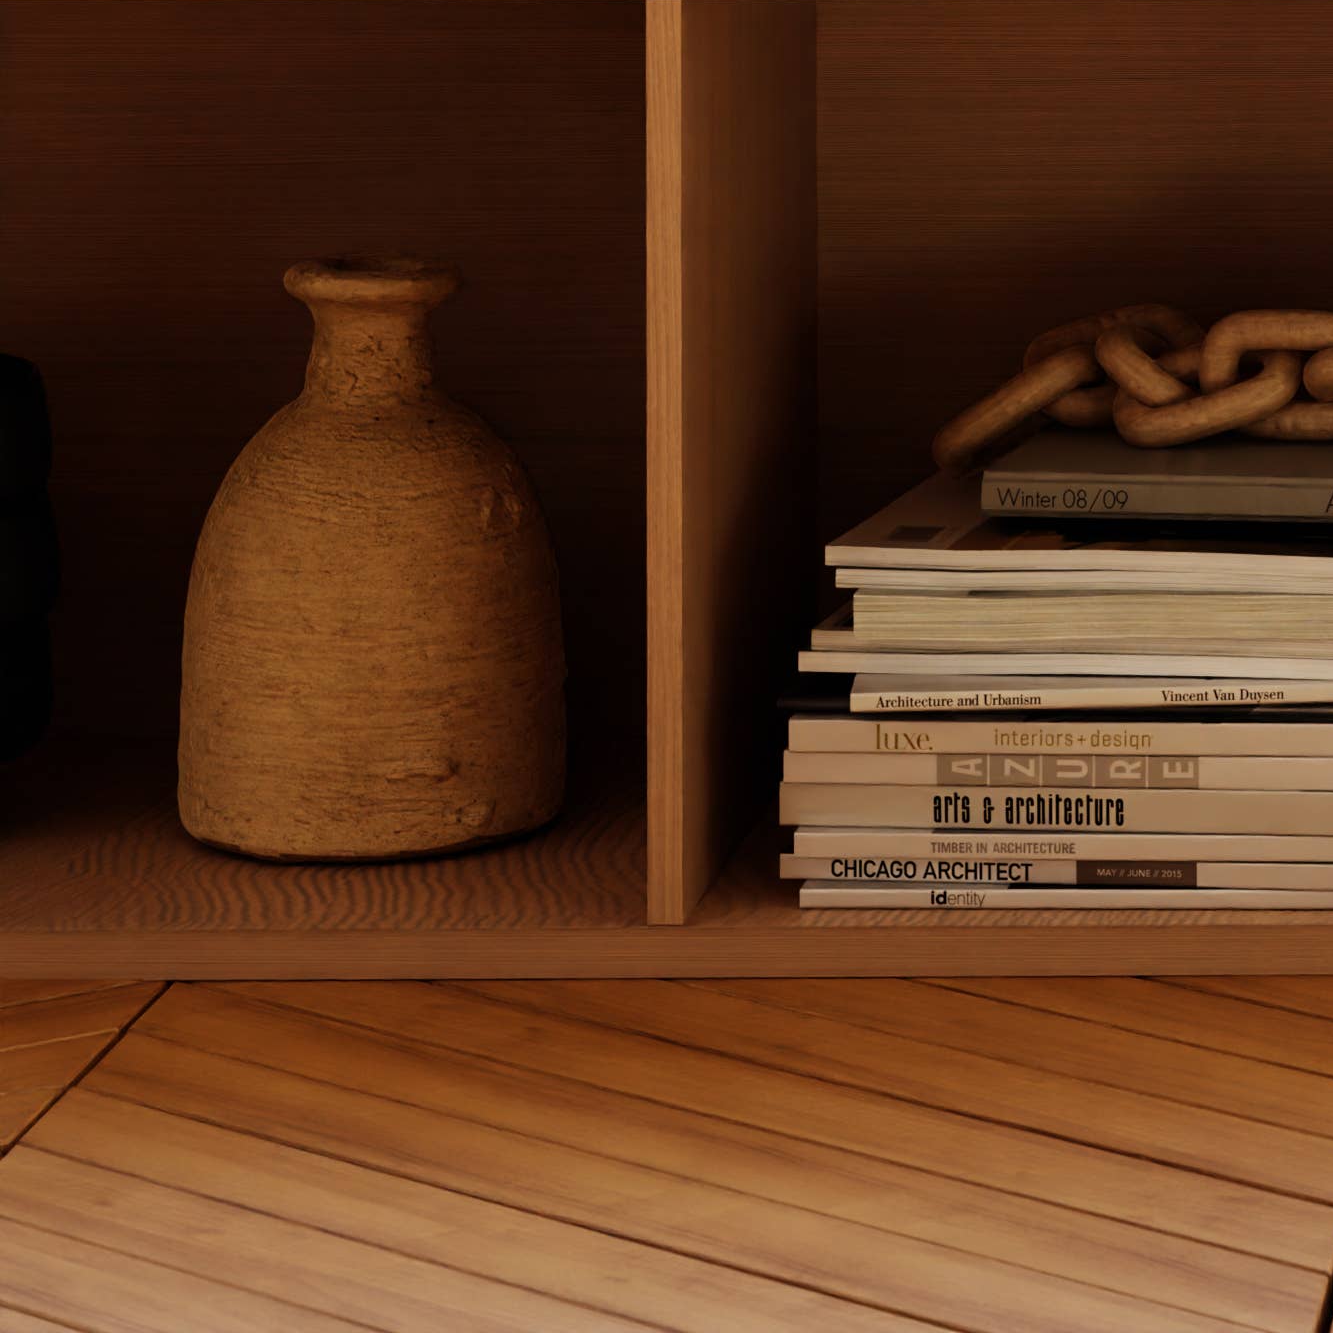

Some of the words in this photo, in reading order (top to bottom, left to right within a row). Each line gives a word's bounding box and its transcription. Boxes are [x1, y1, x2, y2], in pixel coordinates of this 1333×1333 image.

[997, 487, 1057, 509] Winter
[1062, 489, 1129, 513] 08/09
[876, 696, 955, 709] Architecture
[957, 695, 980, 707] and
[983, 694, 1042, 707] Urbanism
[1161, 690, 1209, 703] Vincent
[1213, 689, 1238, 701] Van
[1239, 689, 1285, 703] Duysen
[951, 757, 1195, 780] AZURE
[933, 793, 970, 824] arts
[983, 796, 995, 824] &
[1005, 794, 1125, 826] architecture
[930, 841, 974, 853] TIMBER
[976, 842, 988, 853] IN
[993, 842, 1076, 854] ARCHITECTURE
[830, 859, 917, 880] CHICAGO
[923, 861, 1033, 882] ARCHITECT
[1096, 868, 1117, 877] MAY
[1126, 869, 1151, 878] JUNE
[1161, 869, 1182, 878] 2015
[930, 890, 986, 907] identity
